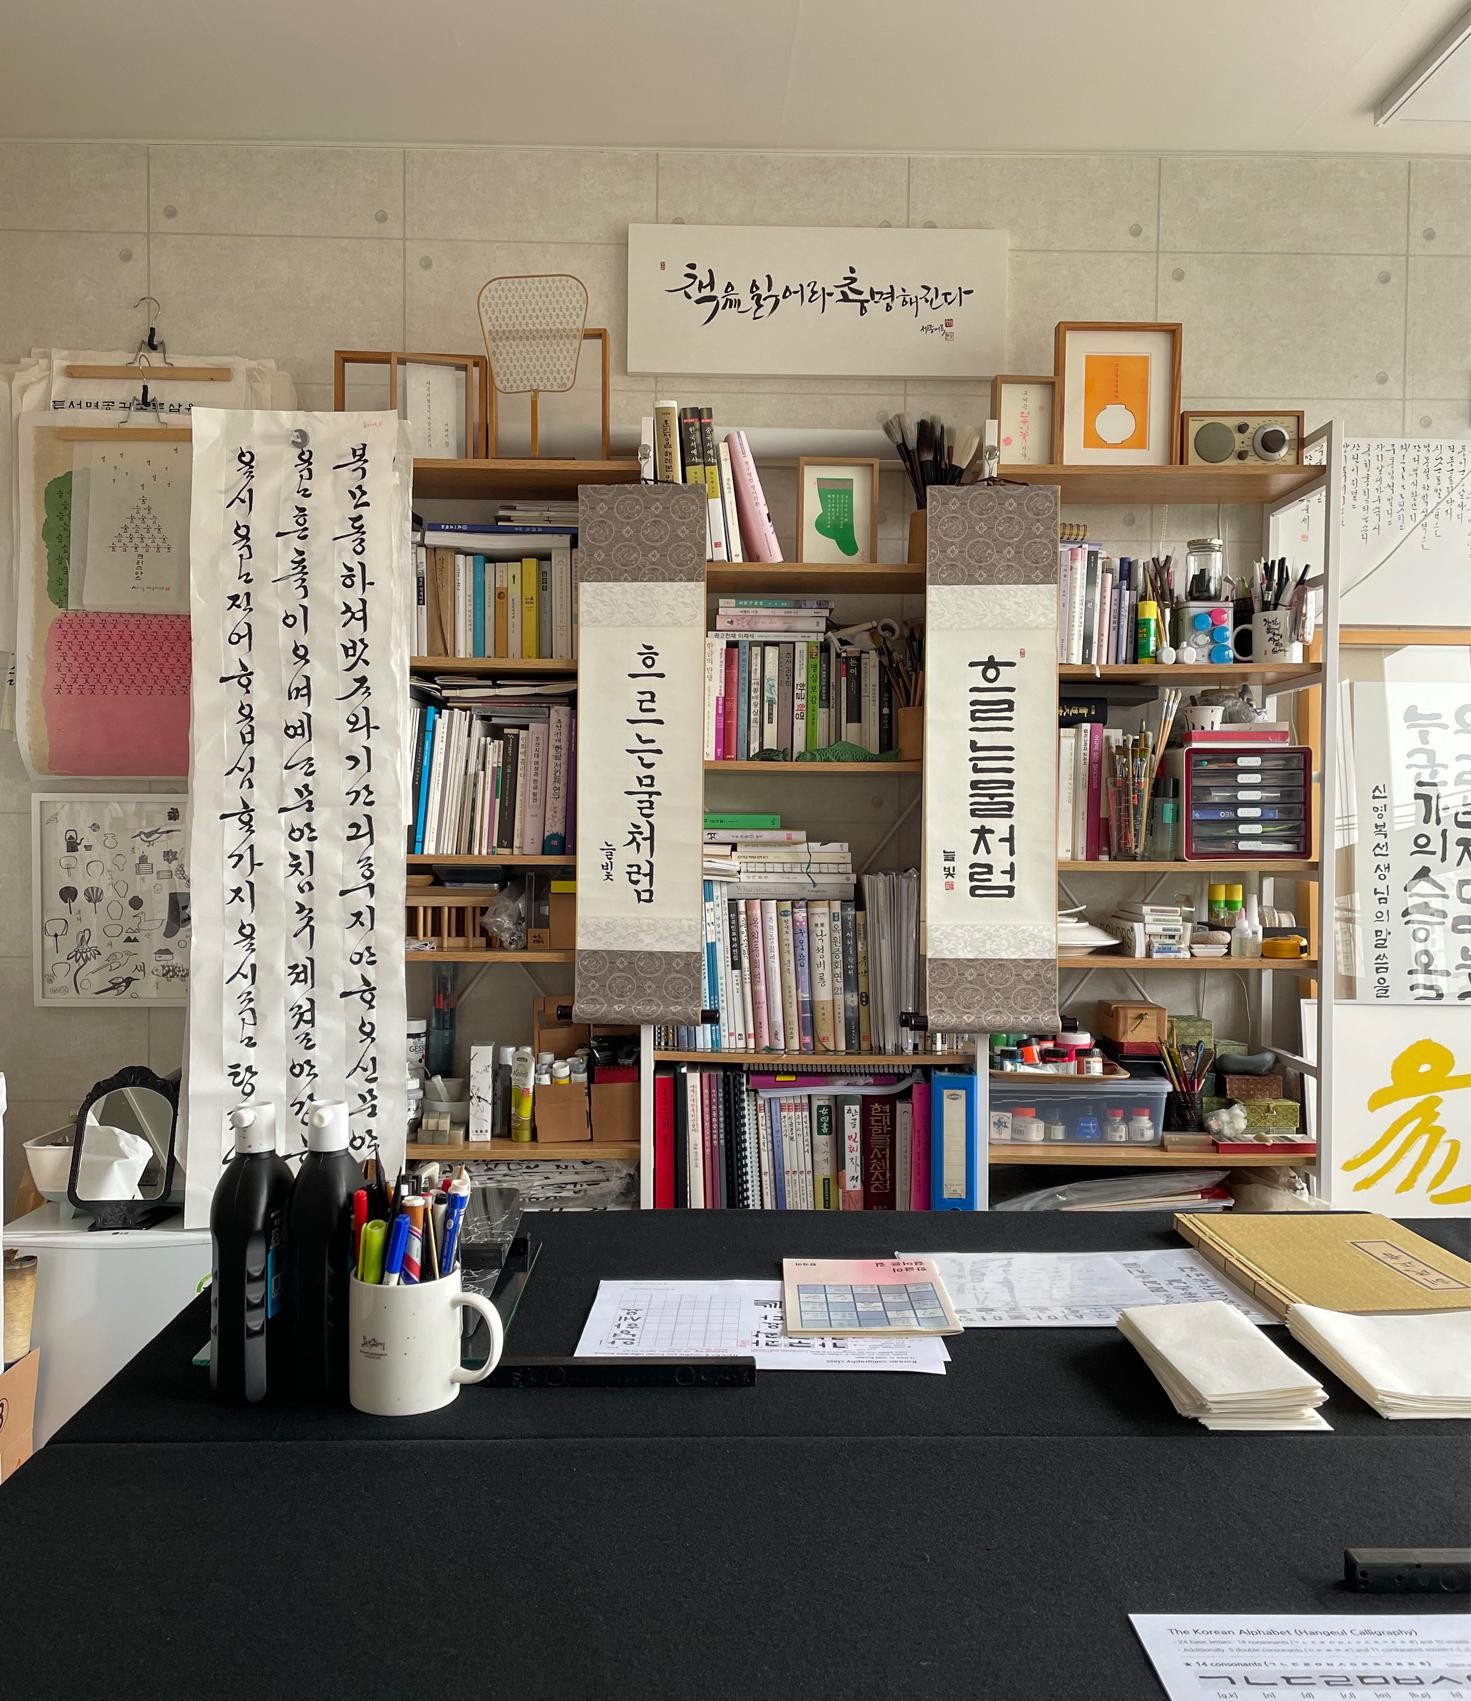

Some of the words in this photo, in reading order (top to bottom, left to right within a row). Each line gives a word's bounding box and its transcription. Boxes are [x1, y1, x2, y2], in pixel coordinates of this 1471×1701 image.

[132, 962, 146, 979] 새
[409, 1045, 425, 1053] GESS
[869, 1103, 891, 1193] 현대한글서체자전
[1168, 1628, 1190, 1636] The
[1193, 1628, 1236, 1636] Korean
[1239, 1628, 1291, 1637] Alphabet
[1294, 1628, 1348, 1637] (Hangeul
[1350, 1628, 1418, 1637] Calligraphy)
[1199, 1675, 1236, 1685] ㄱ
[1244, 1676, 1278, 1685] ㄴ
[1280, 1675, 1317, 1685] ㄷ
[1319, 1675, 1354, 1686] ㄹ
[1356, 1675, 1390, 1685] ㅁ
[1392, 1675, 1425, 1685] ㅂ
[1432, 1675, 1463, 1685] ㅅ
